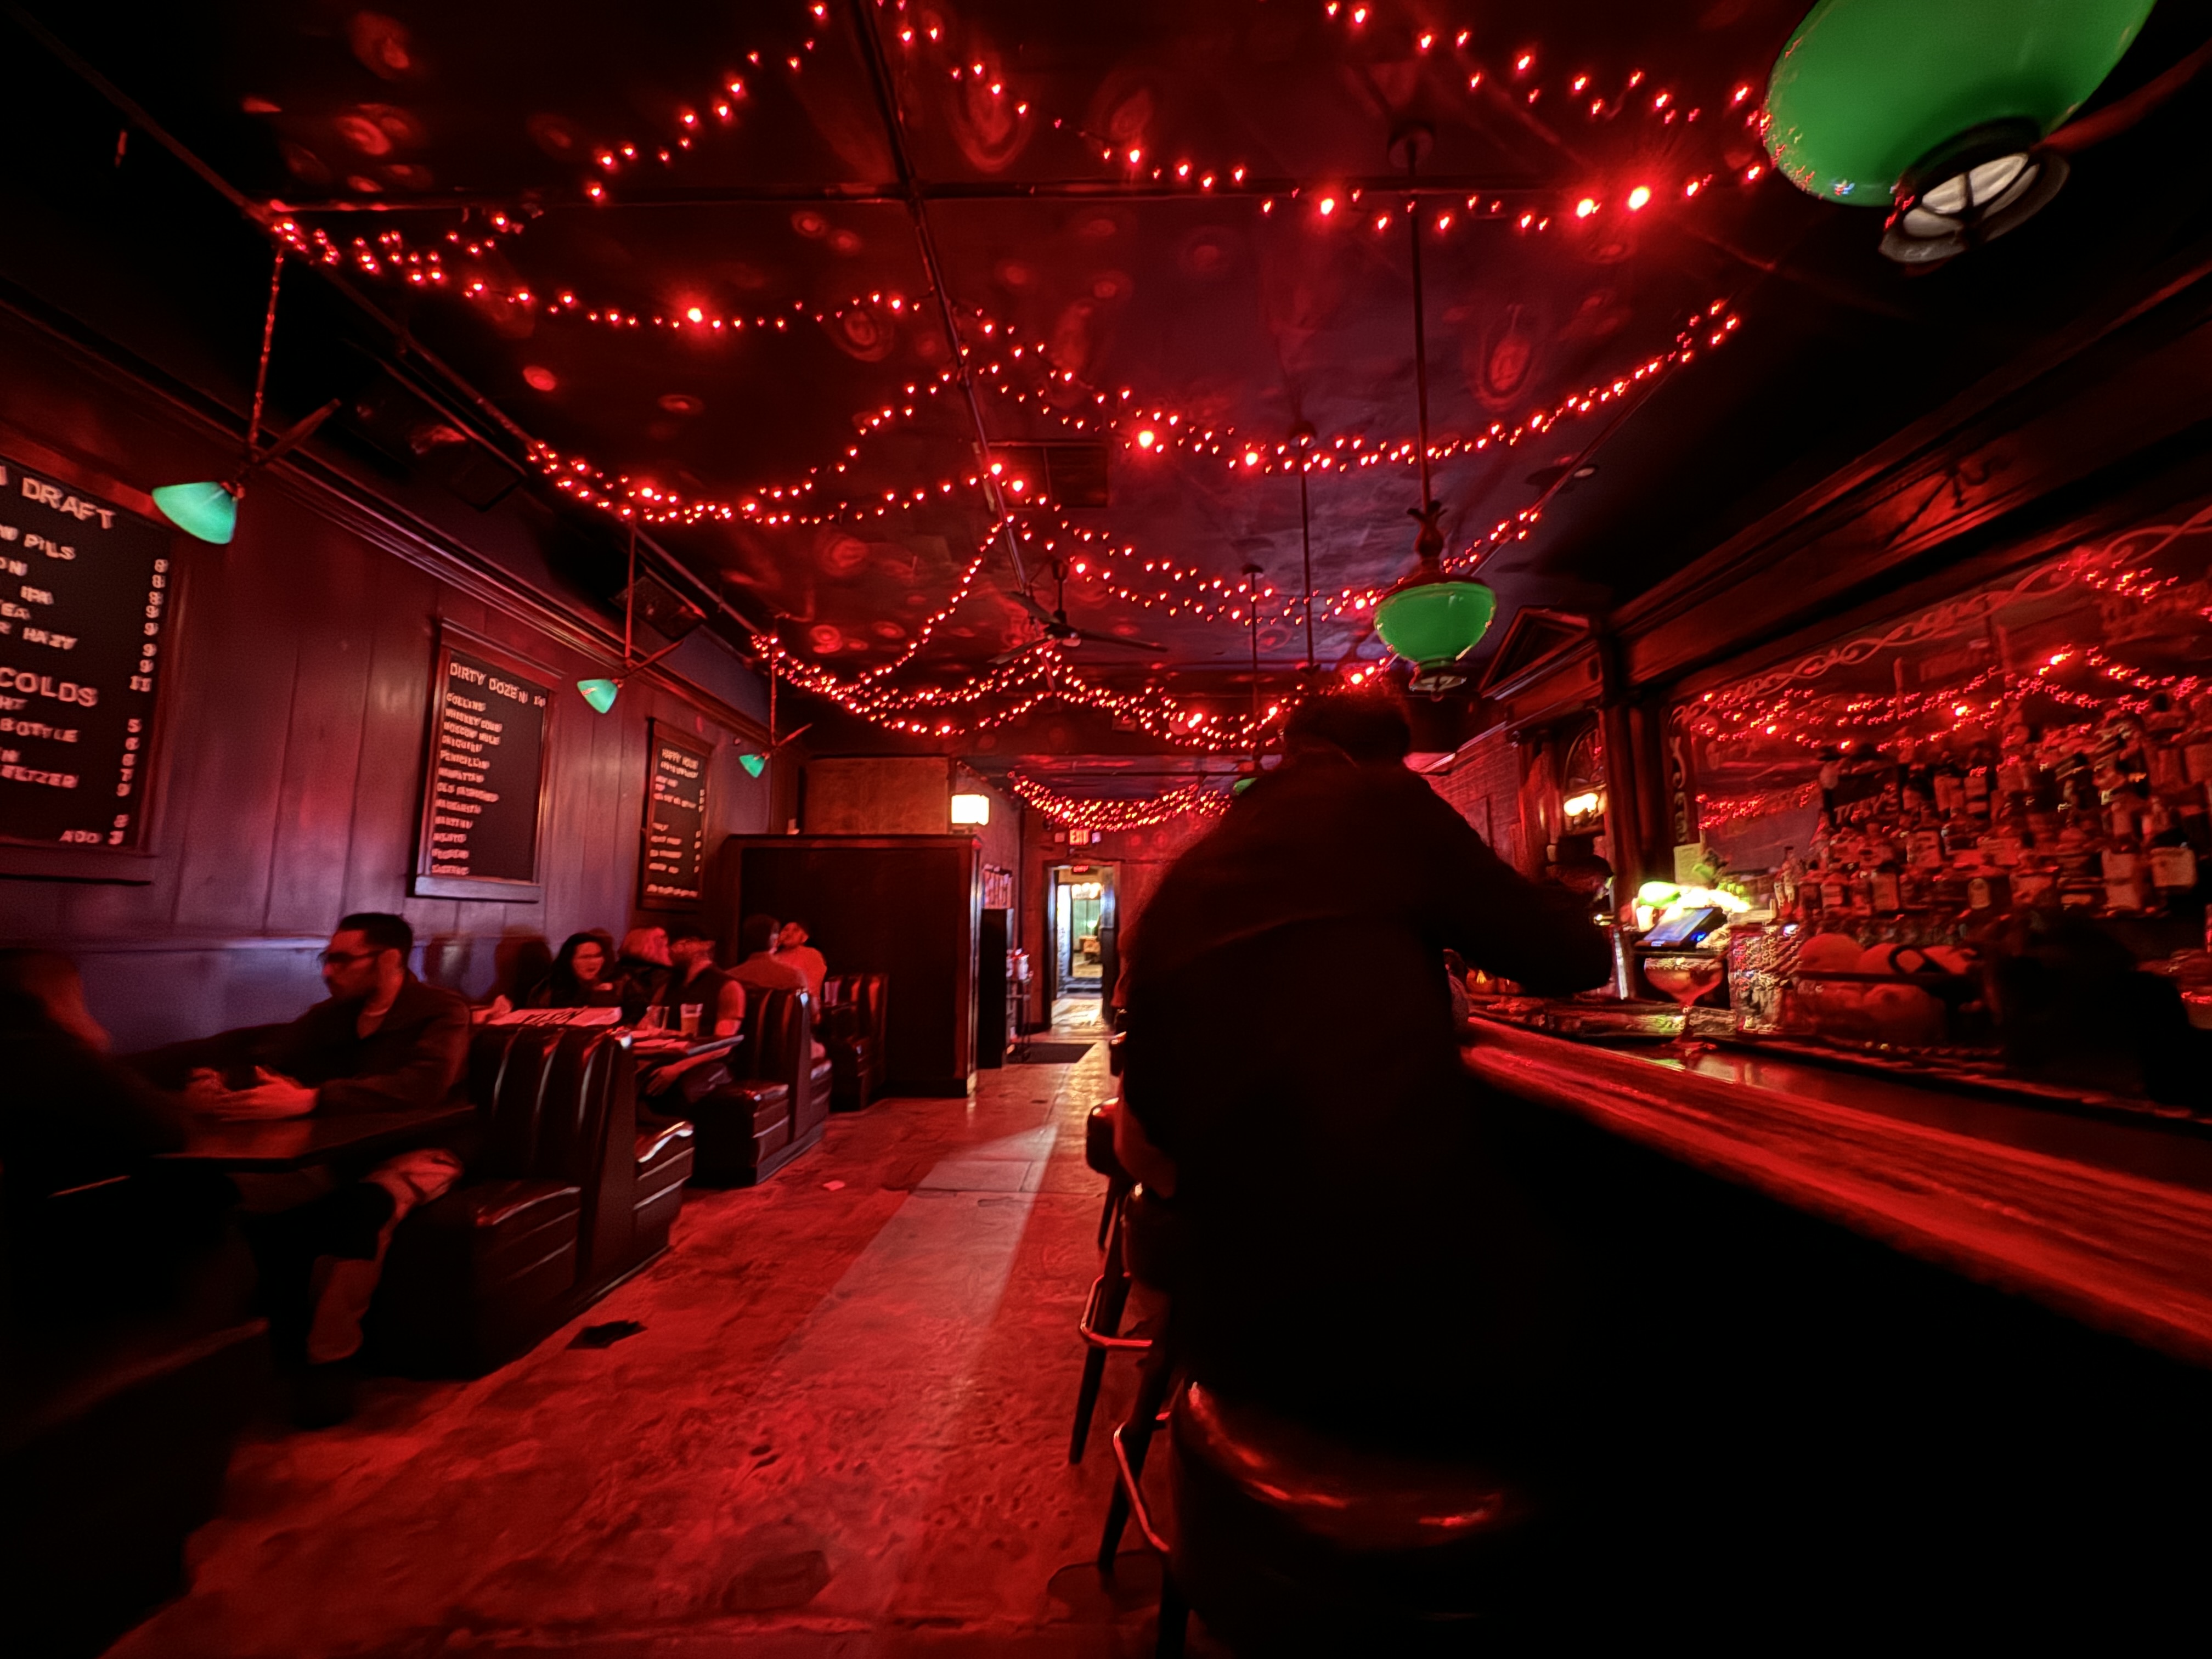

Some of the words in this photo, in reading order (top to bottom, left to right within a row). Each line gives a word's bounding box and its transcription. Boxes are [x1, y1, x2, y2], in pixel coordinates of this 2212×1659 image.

[22, 477, 116, 529] DRAFT
[24, 534, 76, 560] PILS
[152, 574, 166, 588] 8
[149, 591, 163, 605] 8
[0, 599, 31, 620] EA
[145, 605, 159, 618] 9
[144, 622, 159, 636] 9
[142, 644, 157, 657] 9
[139, 659, 154, 673] 9
[0, 667, 98, 707] COLDS
[450, 662, 486, 685] DIRTY
[489, 678, 528, 704] DOZEN
[447, 692, 486, 712] COLLINS
[445, 708, 482, 726] WHISKEY
[0, 718, 78, 742] BOTTLE
[444, 721, 478, 738] MOSCOW
[1069, 829, 1090, 845] EXIT
